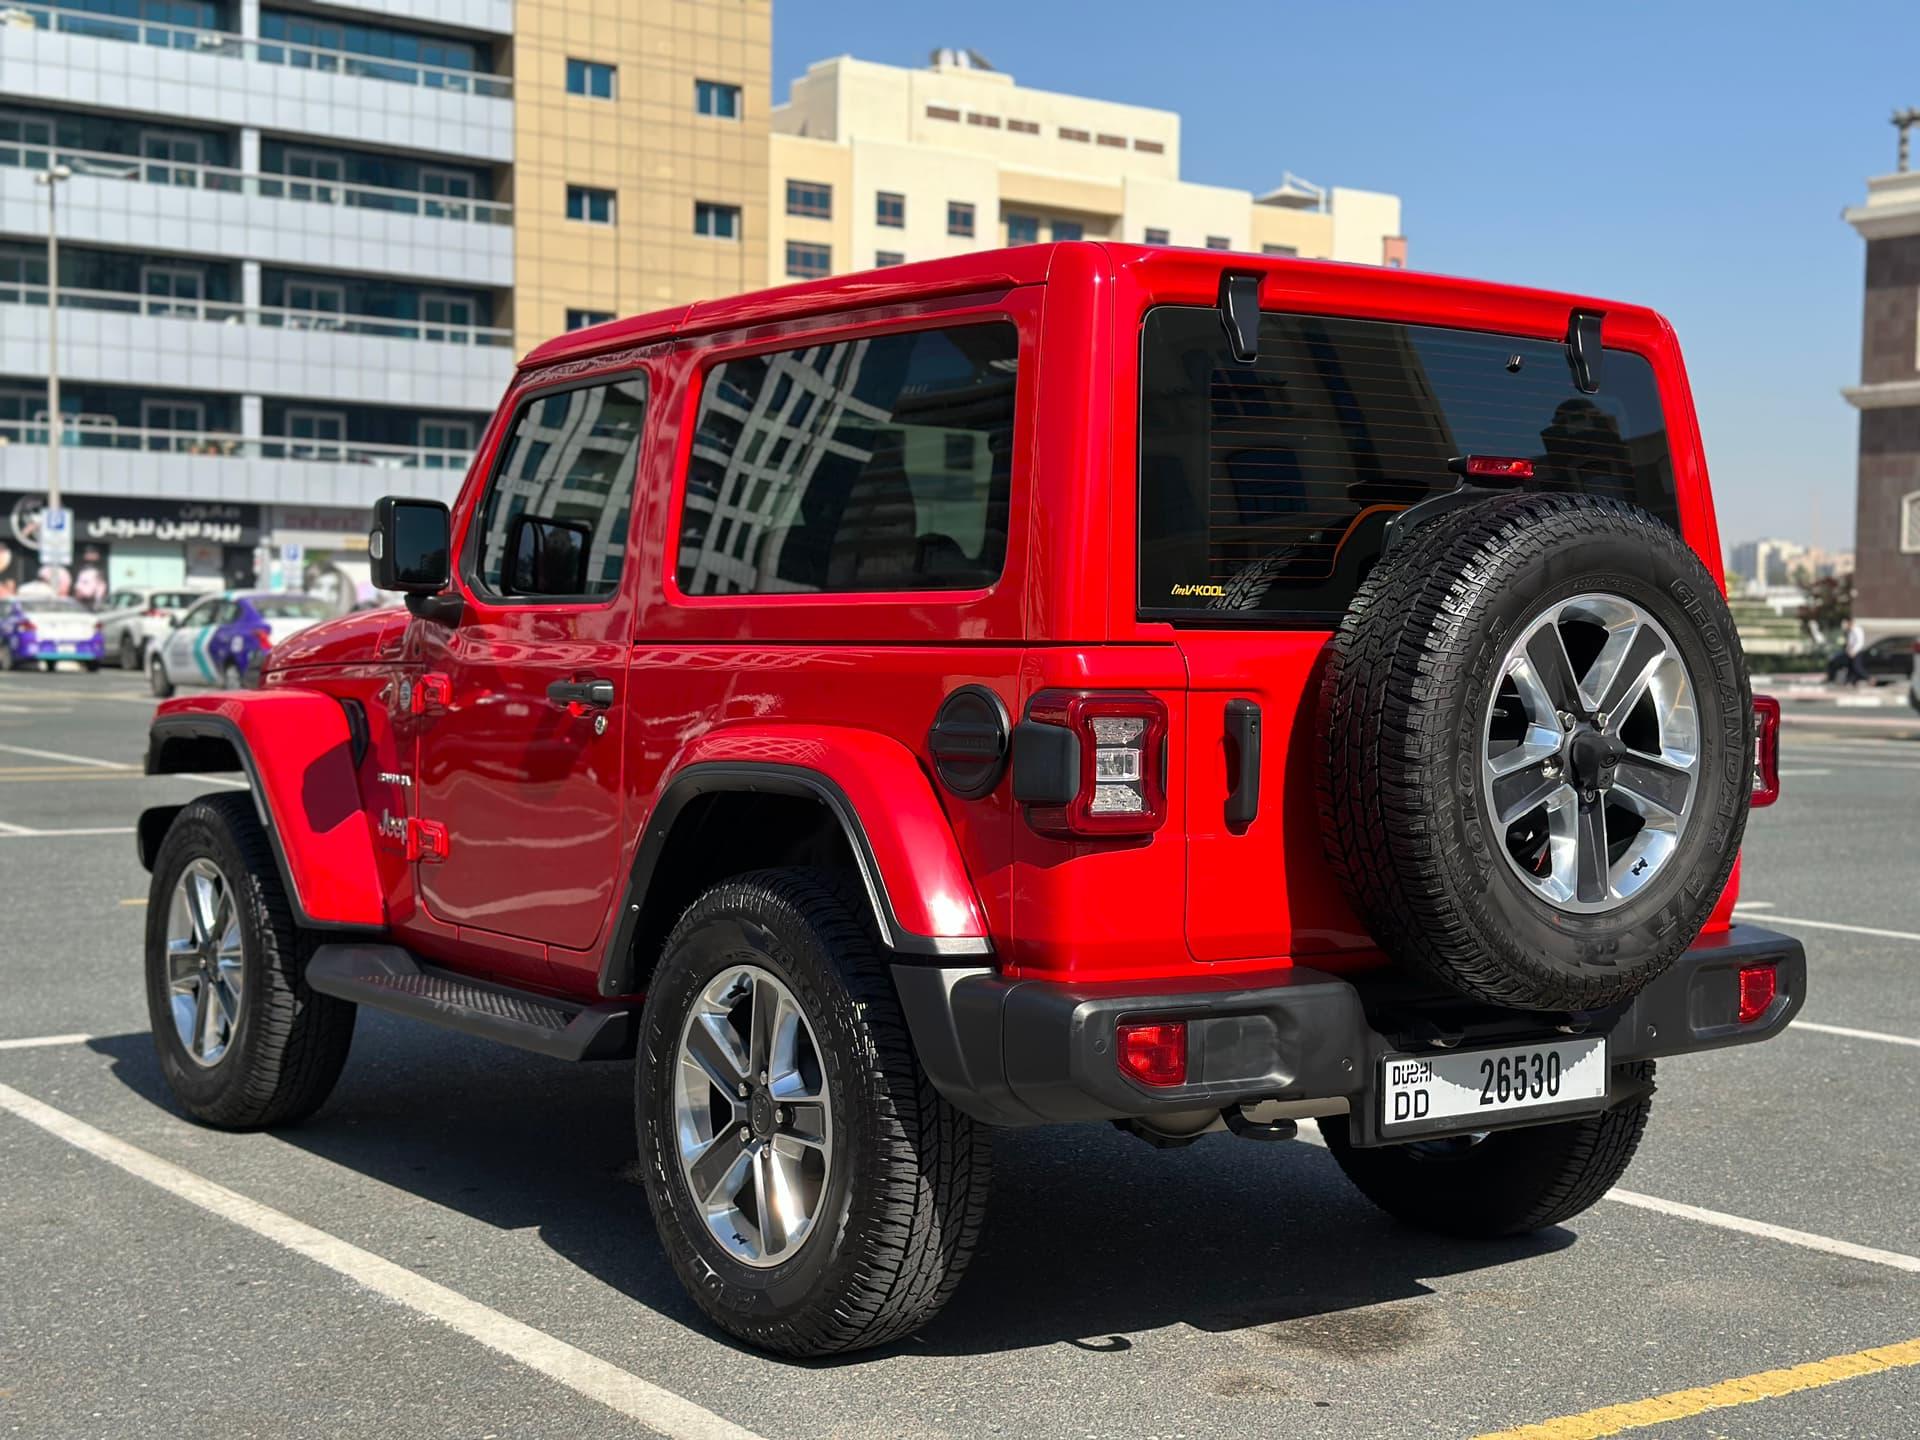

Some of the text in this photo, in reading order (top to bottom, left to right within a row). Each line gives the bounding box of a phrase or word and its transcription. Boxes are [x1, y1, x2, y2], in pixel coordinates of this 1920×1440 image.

[1671, 577, 1743, 854] GEOLANDAR
[378, 807, 408, 845] Jeep
[1480, 1051, 1561, 1106] 26530
[1395, 1089, 1429, 1121] DD
